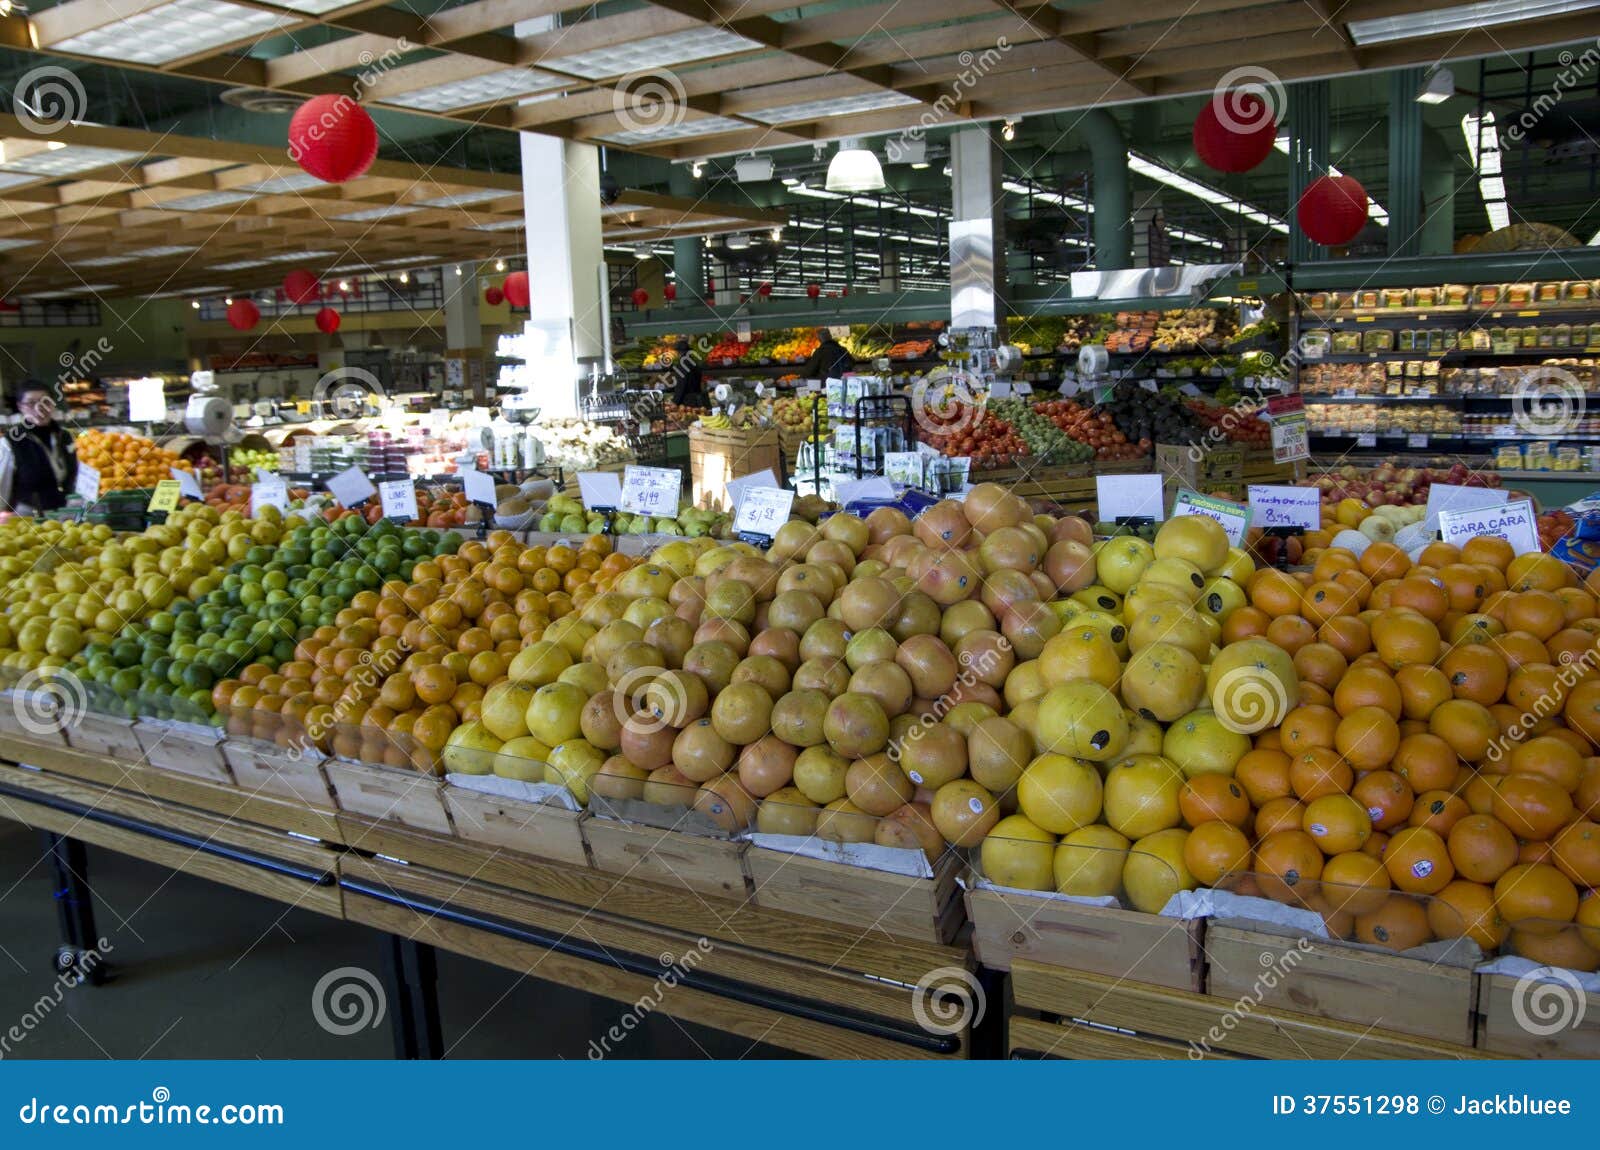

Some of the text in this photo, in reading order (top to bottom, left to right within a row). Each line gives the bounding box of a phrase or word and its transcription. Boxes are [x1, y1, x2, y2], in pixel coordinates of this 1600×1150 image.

[1190, 498, 1226, 512] PRODUCE
[1449, 514, 1527, 535] CARA CARA
